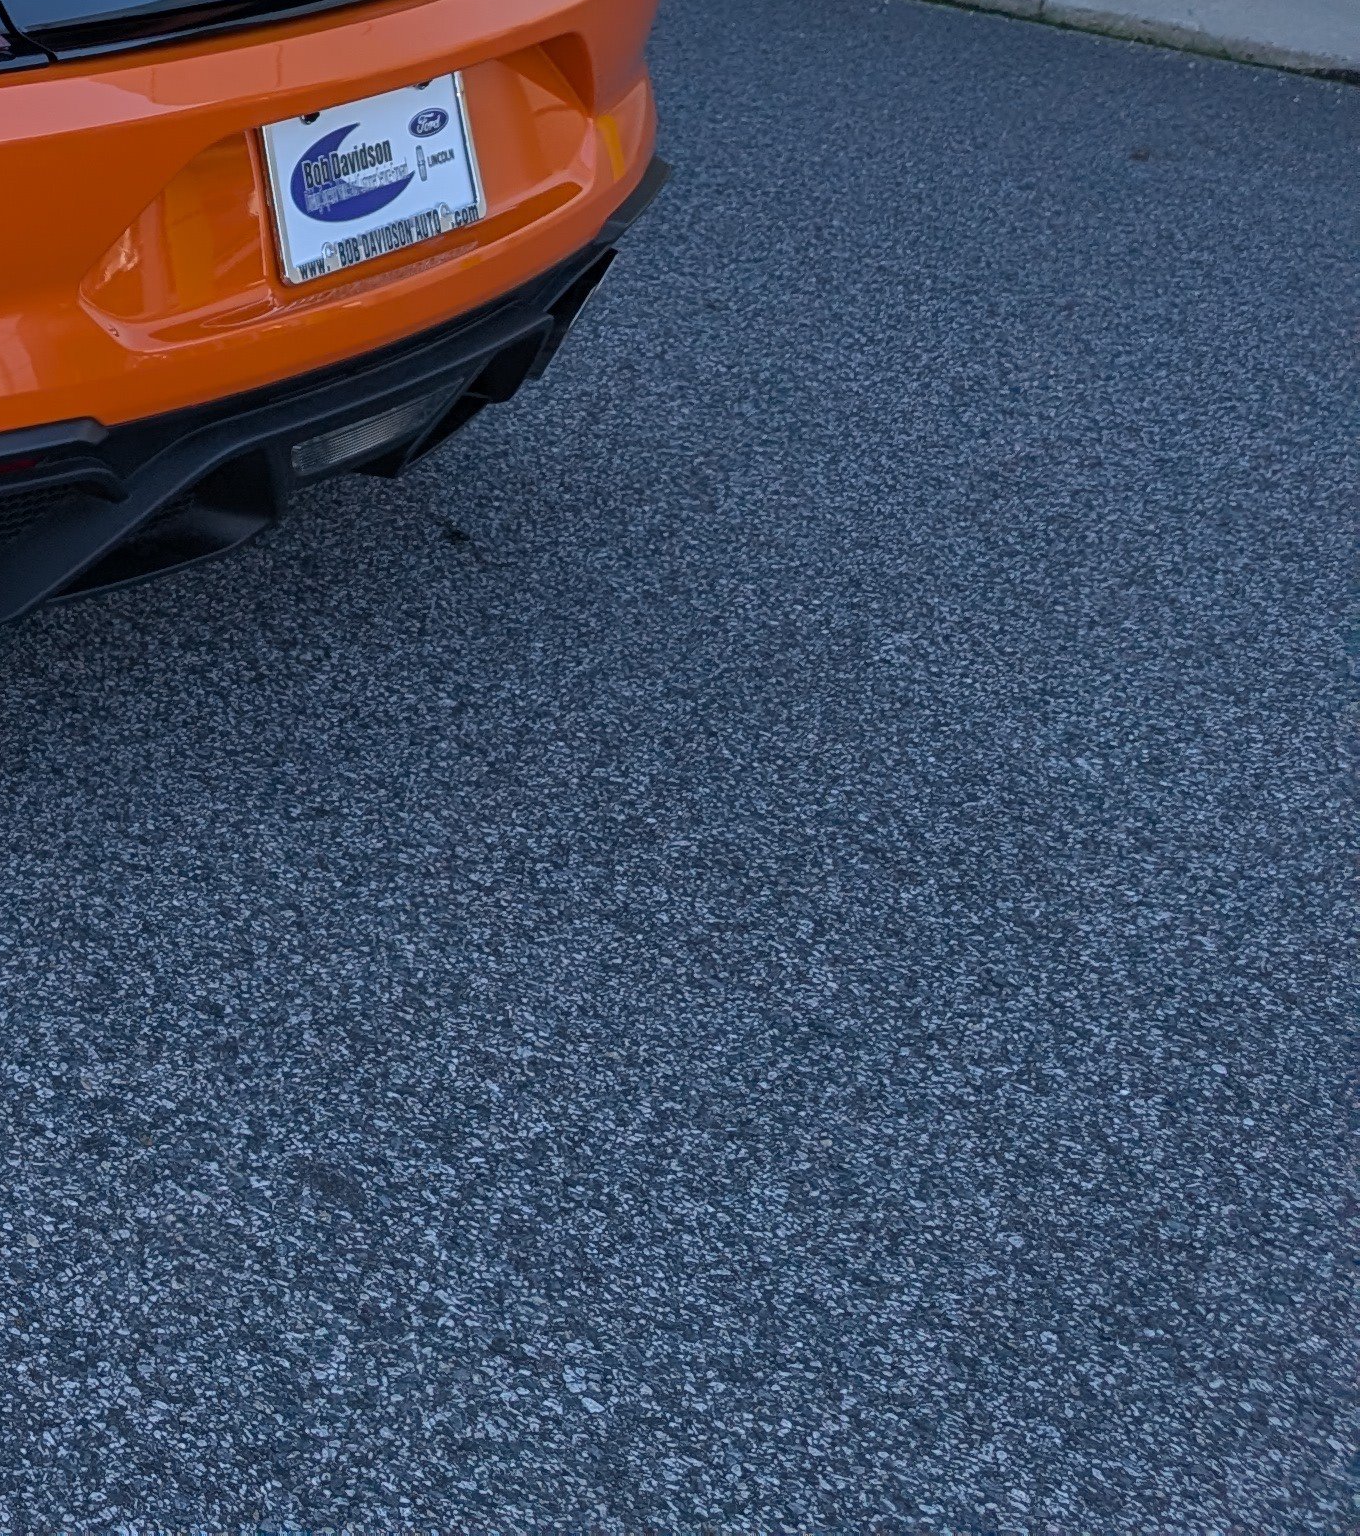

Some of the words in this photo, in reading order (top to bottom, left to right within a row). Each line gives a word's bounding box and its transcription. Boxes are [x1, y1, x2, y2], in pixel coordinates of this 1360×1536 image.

[417, 112, 442, 133] Ford
[304, 155, 331, 189] Bob
[330, 139, 393, 180] Davidson
[426, 148, 455, 168] LINCOLN
[337, 240, 361, 265] BOB
[361, 219, 414, 258] DAVIDSON
[414, 208, 442, 240] AUTO
